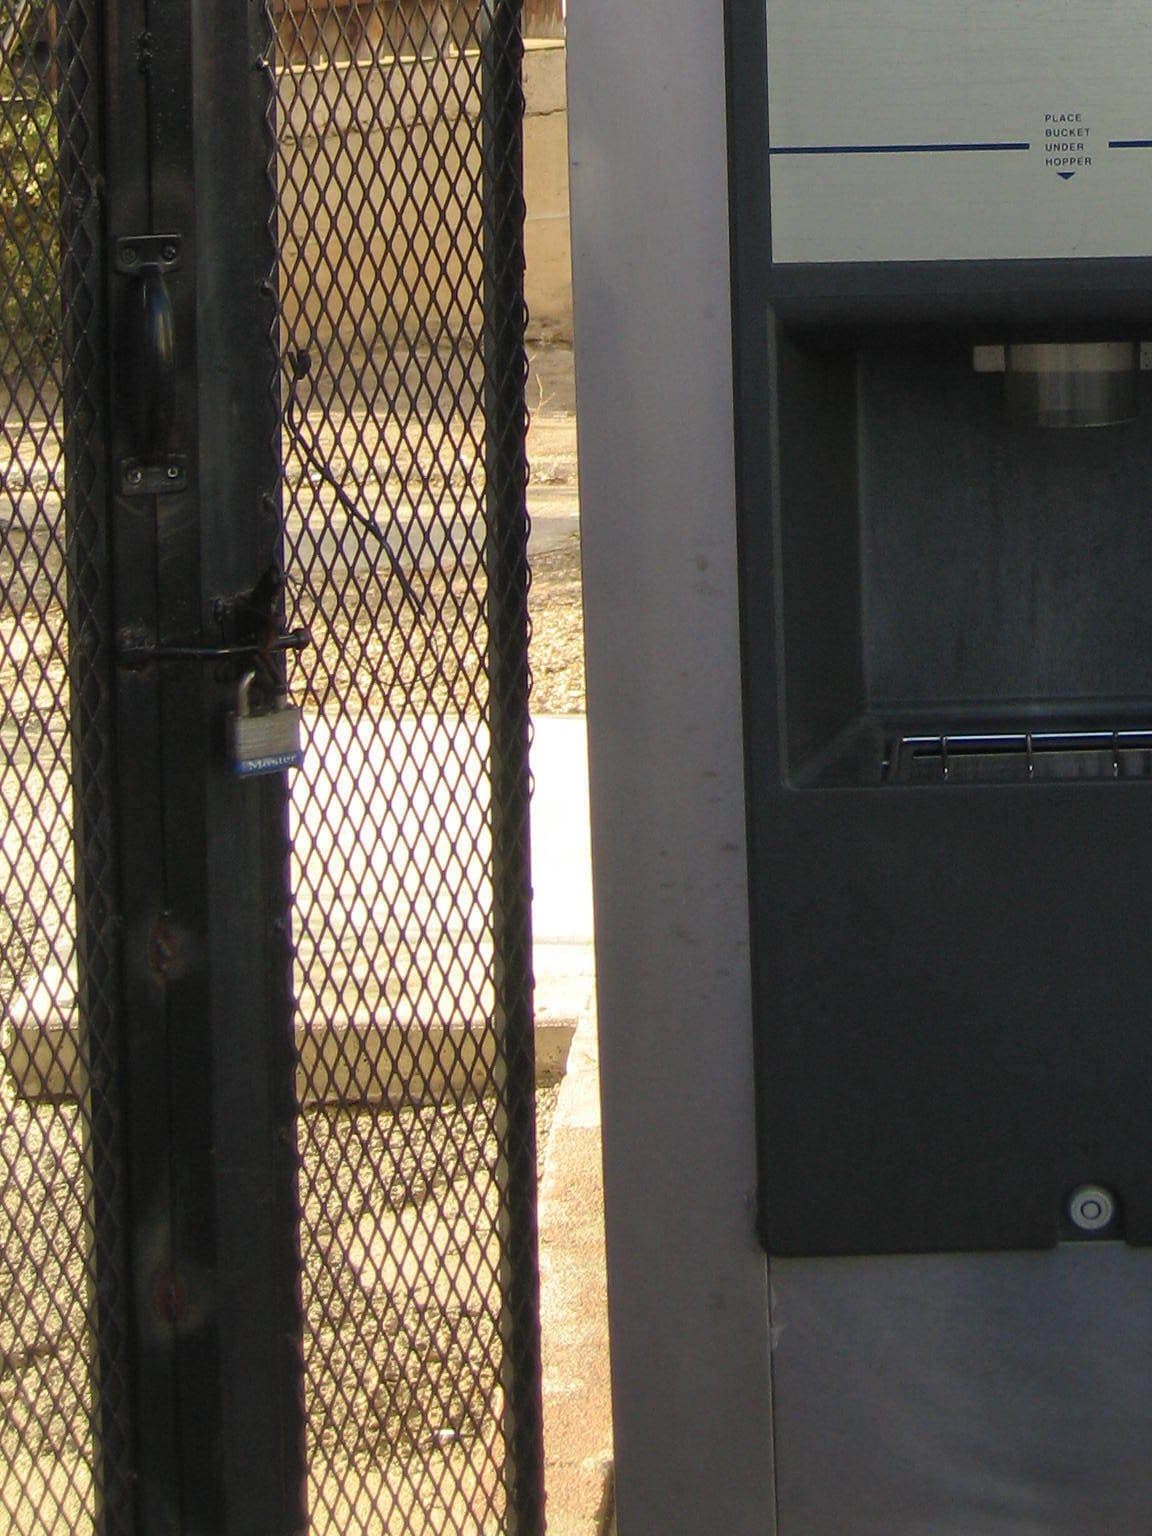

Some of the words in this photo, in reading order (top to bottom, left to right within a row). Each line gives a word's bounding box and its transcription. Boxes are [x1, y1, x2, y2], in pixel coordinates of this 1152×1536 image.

[1044, 114, 1082, 123] PLACE
[1045, 128, 1090, 137] BUCKET
[1045, 143, 1084, 152] UNDER
[1045, 157, 1092, 166] HOPPER
